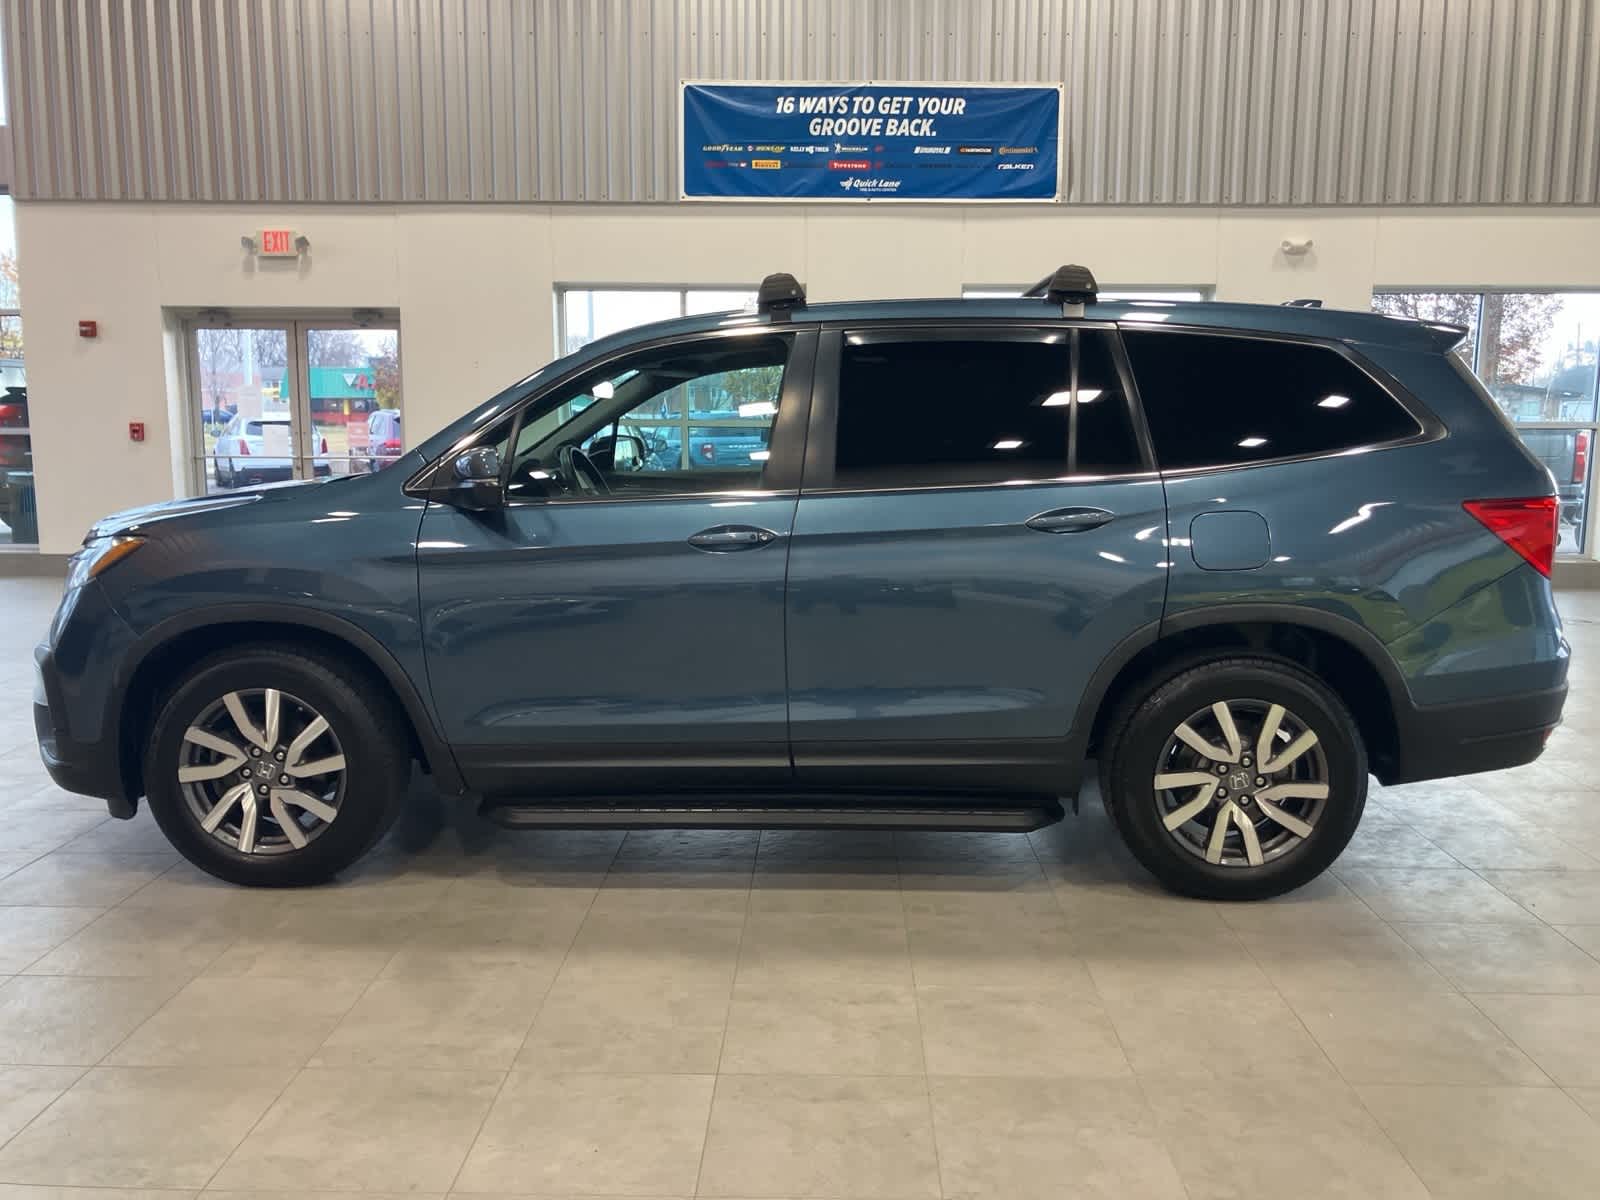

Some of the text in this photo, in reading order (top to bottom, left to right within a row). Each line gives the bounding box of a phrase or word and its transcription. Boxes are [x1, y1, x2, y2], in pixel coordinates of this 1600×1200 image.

[776, 96, 966, 115] 16 WAYS TO GET YOUR
[809, 118, 937, 137] GROOVE BACK.
[702, 144, 743, 152] GOODYEAR
[853, 178, 901, 188] Quick Lane
[263, 231, 289, 253] EXIT
